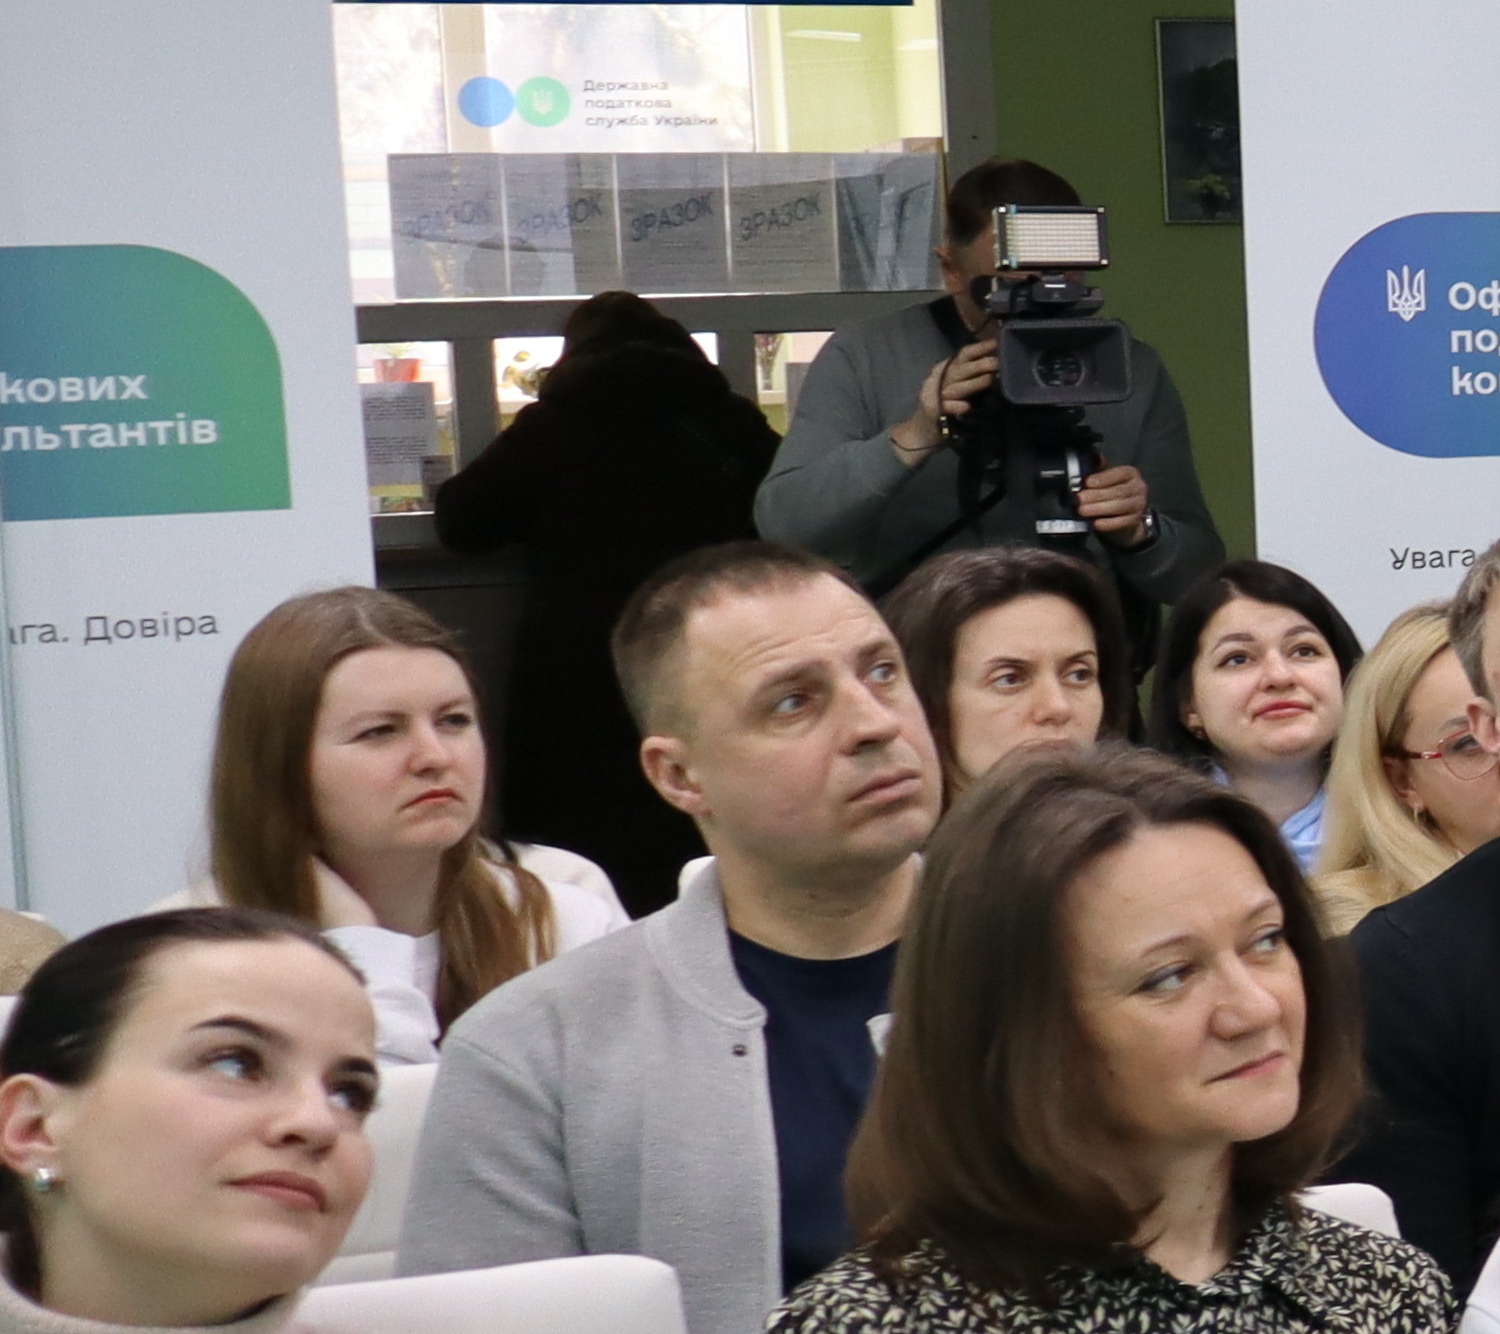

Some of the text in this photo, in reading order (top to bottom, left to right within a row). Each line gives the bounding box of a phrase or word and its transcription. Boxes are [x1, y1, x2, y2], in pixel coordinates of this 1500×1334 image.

[583, 79, 668, 94] Державна
[585, 97, 672, 111] податкова
[586, 113, 719, 129] служба України
[630, 190, 714, 242] ЗРАЗОК
[740, 191, 820, 242] ЗРАЗОК
[84, 611, 218, 646] Довіра
